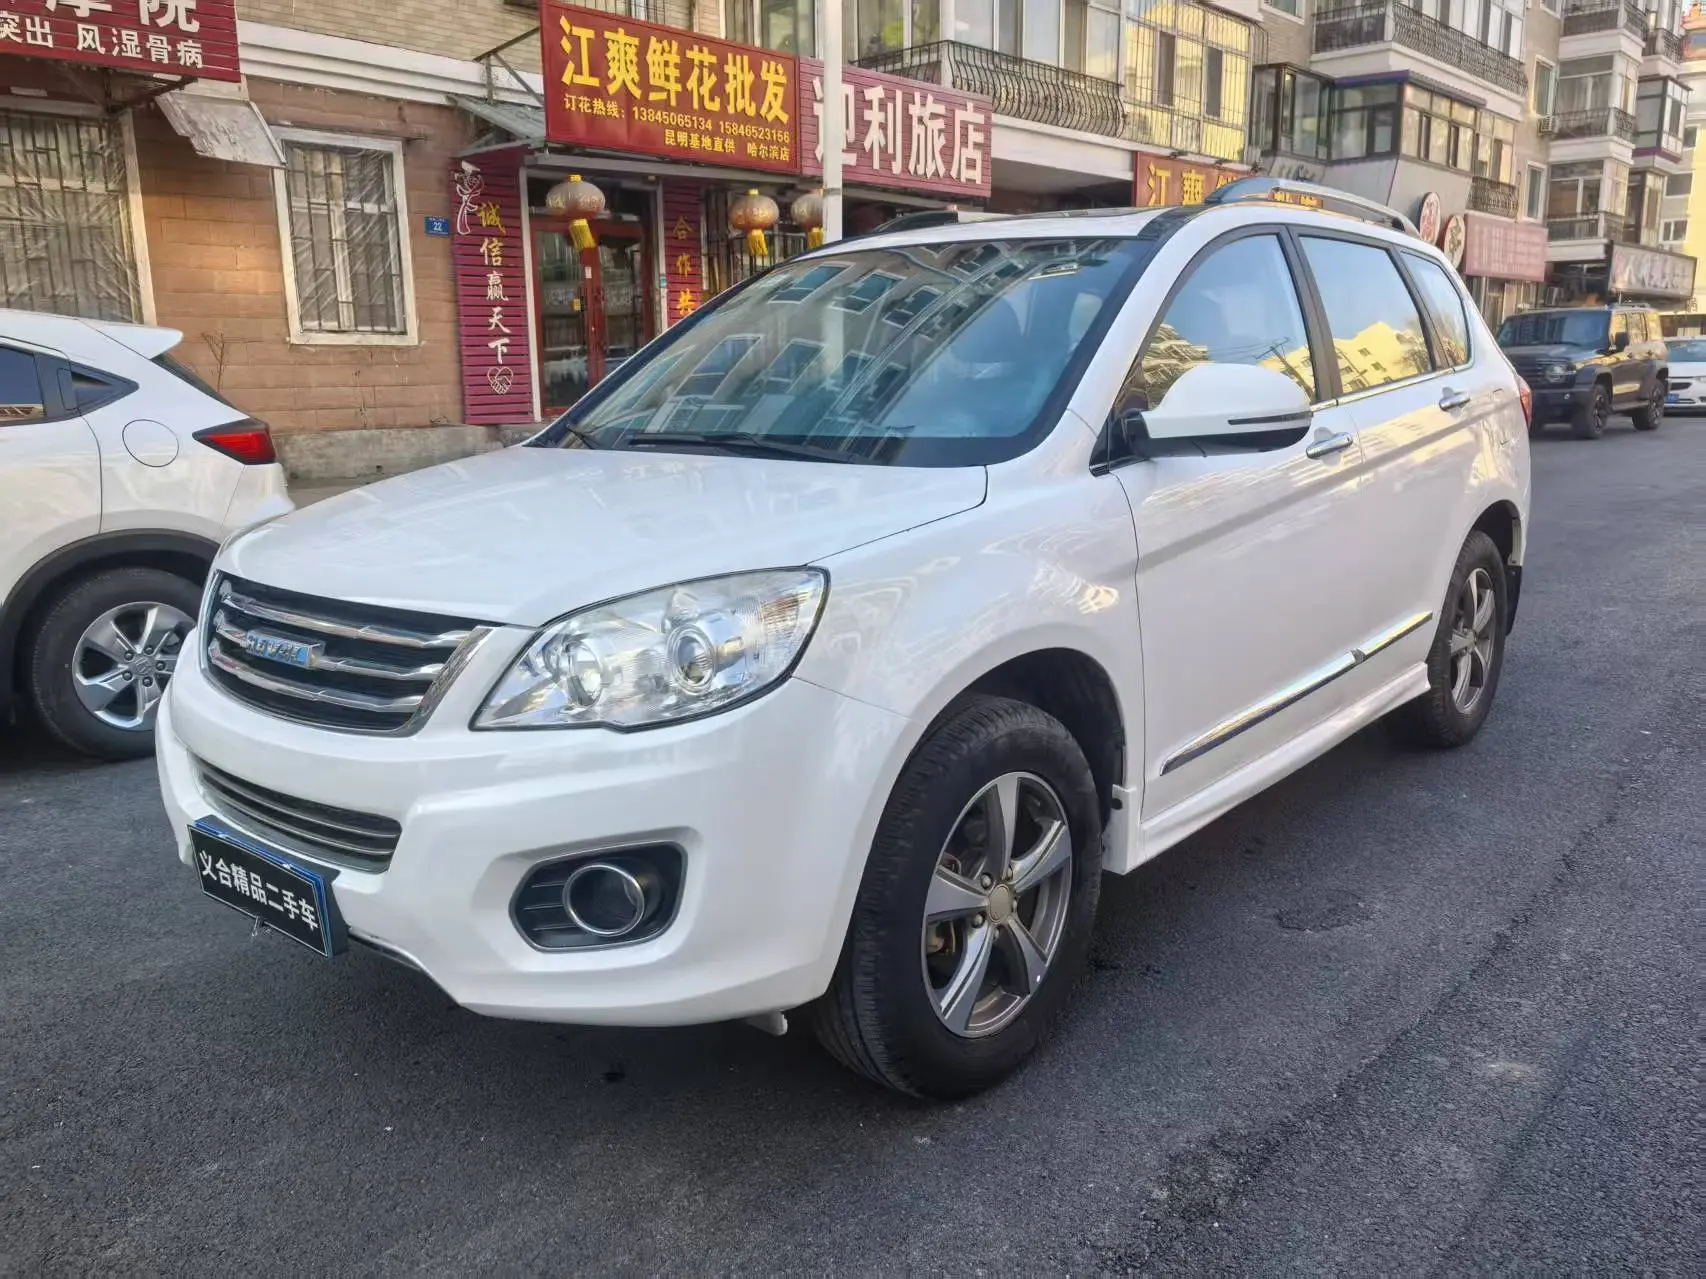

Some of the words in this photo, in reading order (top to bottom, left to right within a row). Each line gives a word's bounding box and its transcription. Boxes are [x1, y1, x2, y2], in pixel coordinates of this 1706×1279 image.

[76, 23, 204, 69] 风湿骨病
[559, 15, 790, 124] 江爽鲜花批发
[632, 106, 713, 132] 13845065134
[719, 120, 791, 143] 15846523156
[664, 128, 736, 154] 昆明基地直供
[746, 142, 791, 162] 哈尔滨店
[199, 850, 319, 931] 义合精品二手车
